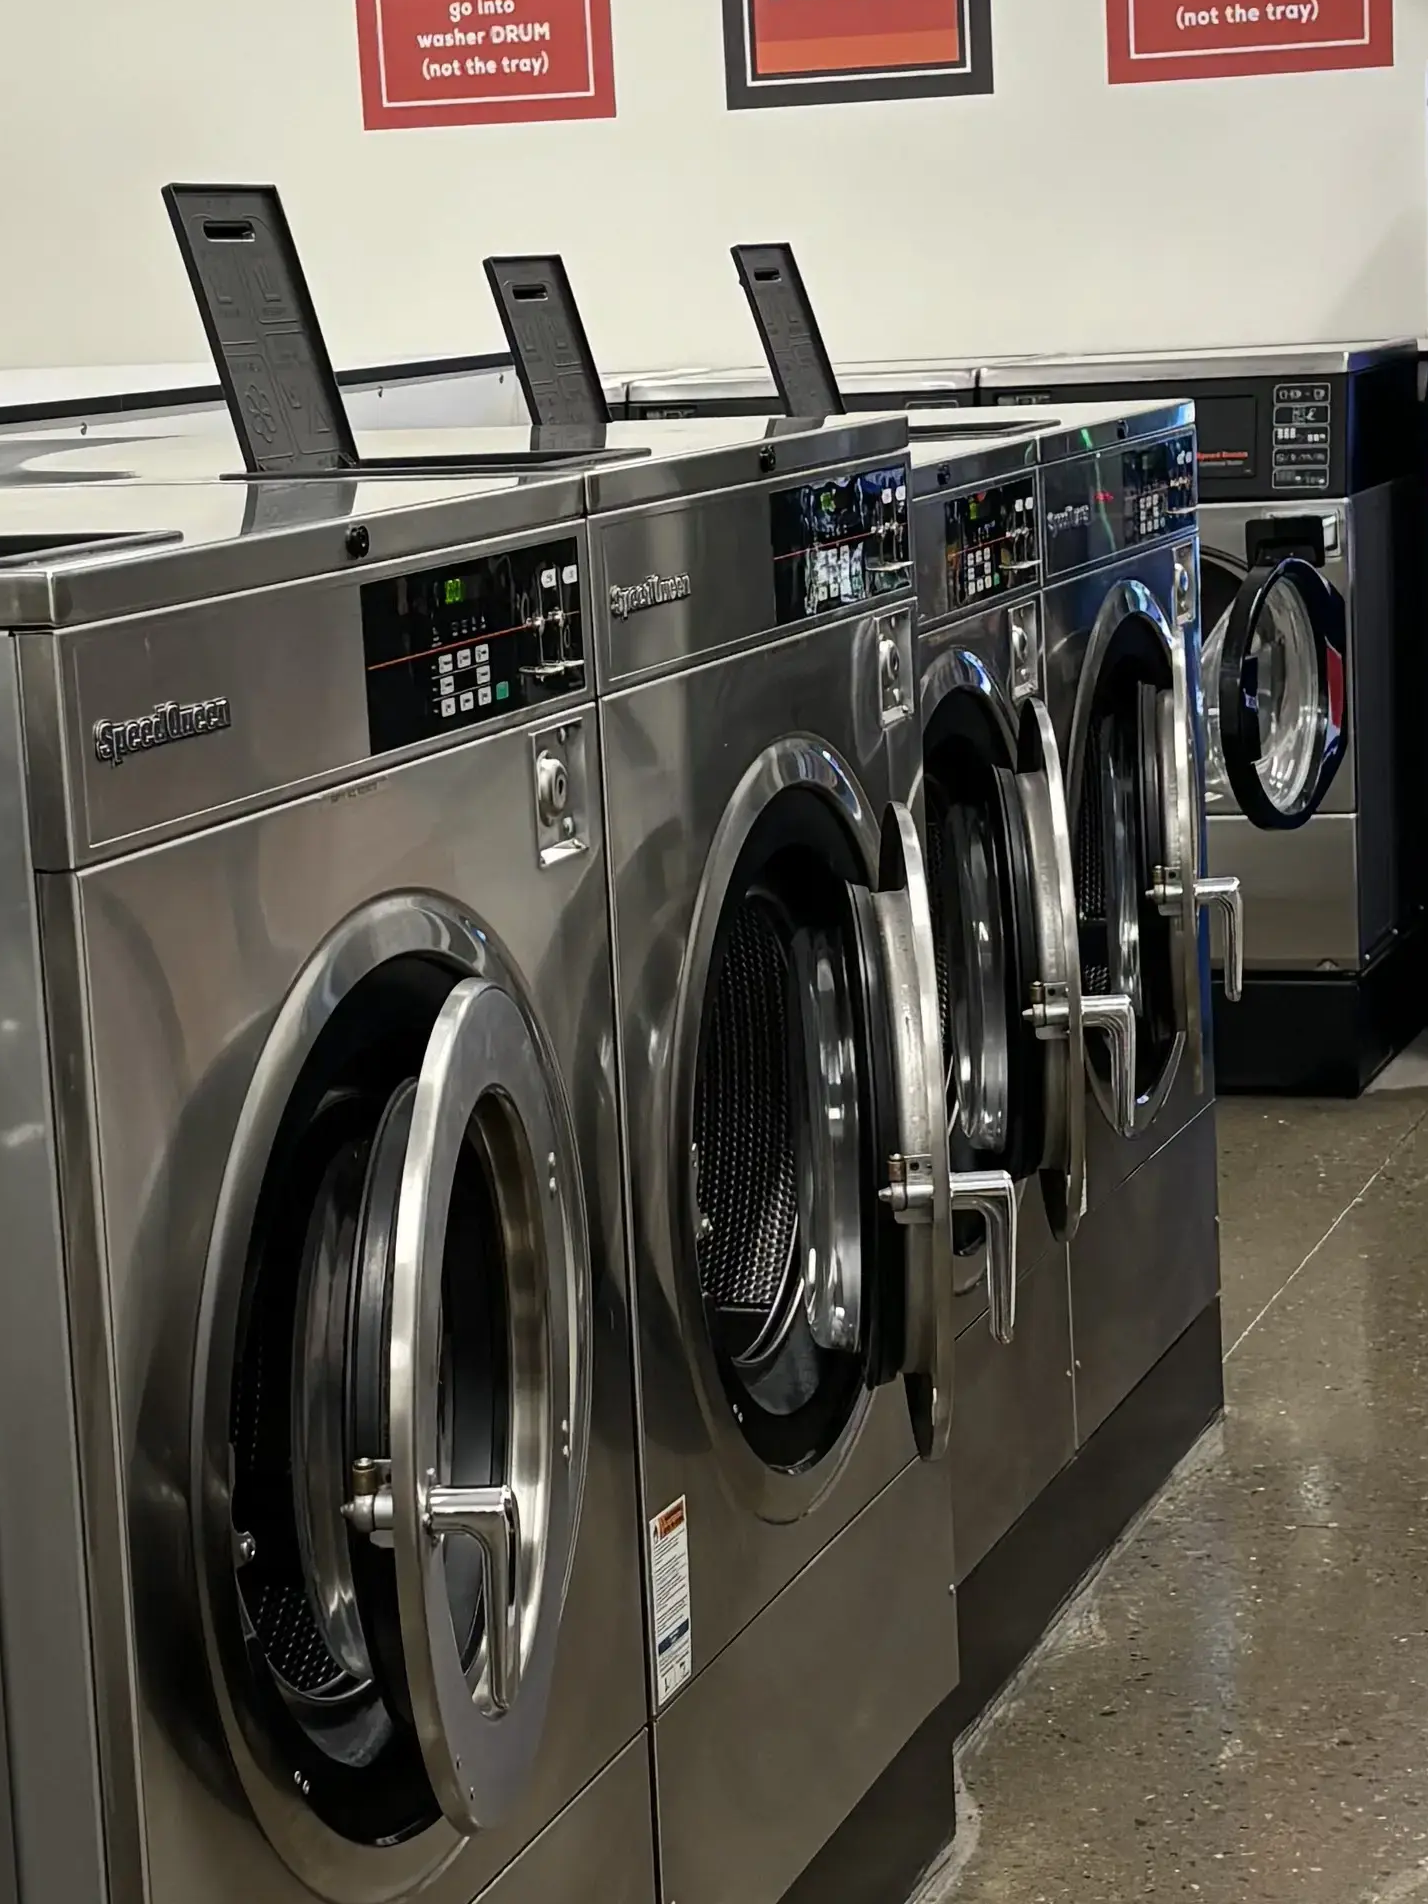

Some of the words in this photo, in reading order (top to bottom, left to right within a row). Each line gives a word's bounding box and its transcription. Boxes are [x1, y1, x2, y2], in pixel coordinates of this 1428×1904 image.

[448, 1, 473, 23] go
[1175, 5, 1220, 30] (not
[1224, 3, 1260, 24] the
[416, 27, 486, 49] washer
[489, 21, 551, 44] DRUM
[421, 57, 462, 81] (not
[464, 55, 498, 76] the
[500, 50, 550, 77] tray)
